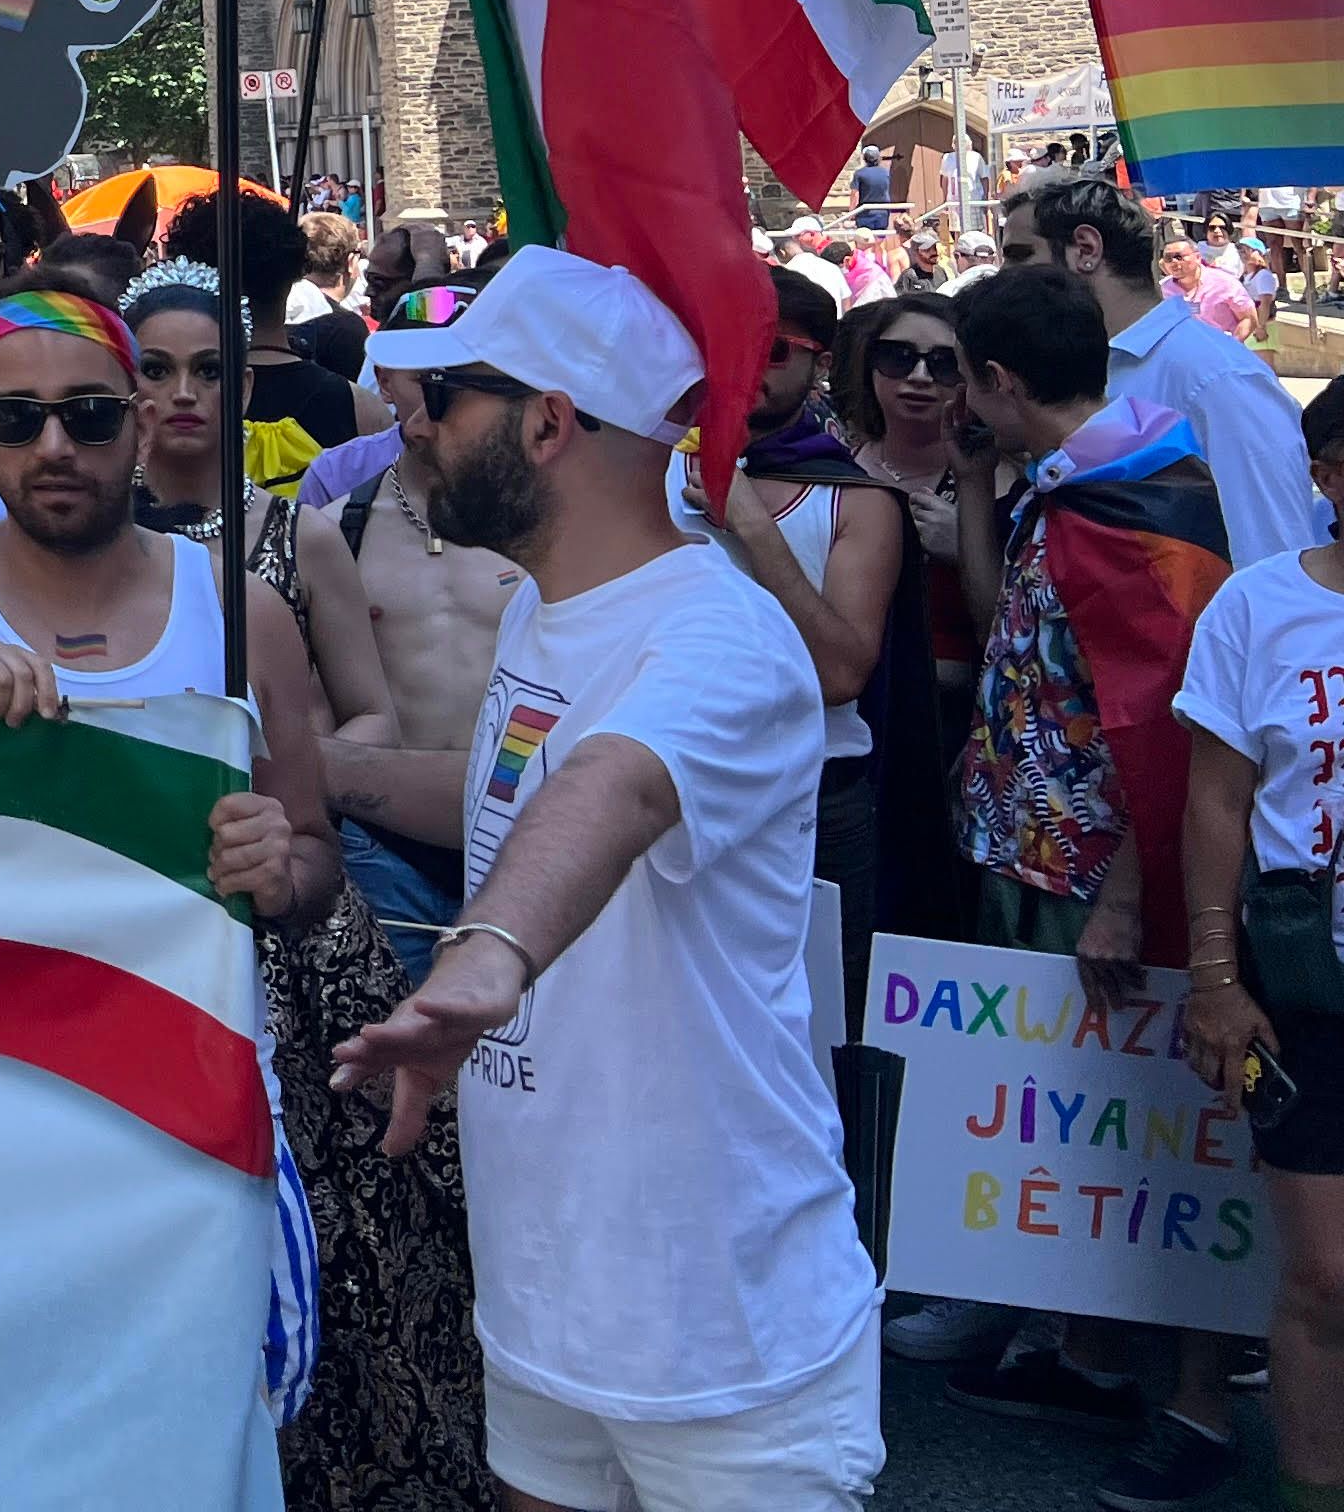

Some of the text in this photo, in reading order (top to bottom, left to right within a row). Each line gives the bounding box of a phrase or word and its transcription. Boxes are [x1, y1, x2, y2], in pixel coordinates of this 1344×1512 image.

[997, 82, 1025, 99] FREE
[992, 107, 1027, 126] WATER
[470, 1044, 537, 1093] PRIDE
